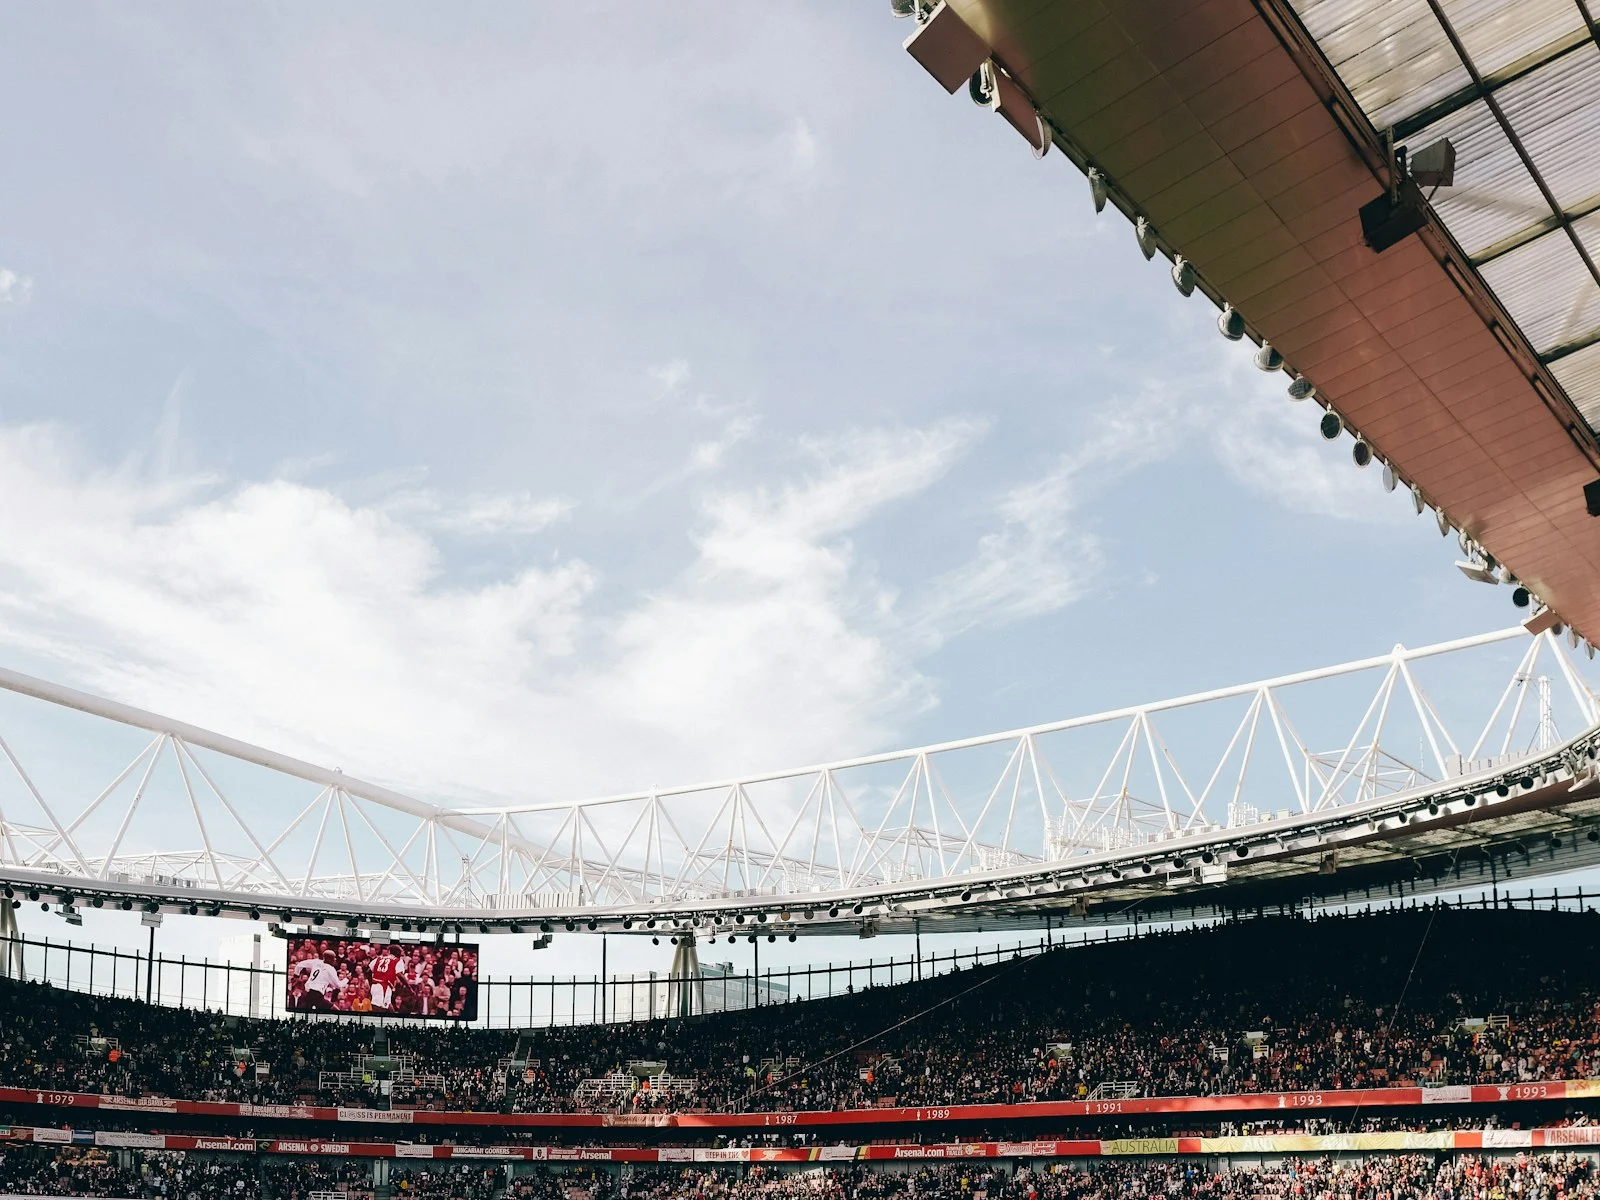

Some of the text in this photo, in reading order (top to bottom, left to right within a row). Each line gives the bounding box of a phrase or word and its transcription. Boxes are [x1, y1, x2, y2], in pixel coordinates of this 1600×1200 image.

[377, 959, 390, 972] 23
[311, 969, 319, 981] 9
[1516, 1086, 1547, 1098] 1993
[49, 1094, 75, 1105] 1979
[113, 1097, 136, 1105] ARSENAL
[1292, 1095, 1322, 1106] 1993
[1096, 1103, 1122, 1113] 1991
[366, 1111, 373, 1119] IS
[374, 1112, 412, 1121] PERMANENT
[775, 1115, 798, 1124] 1987
[926, 1109, 950, 1119] 1989
[1550, 1129, 1589, 1144] ARSENAL
[195, 1139, 254, 1151] Arsenal.com
[278, 1141, 350, 1154] ARSENAL SWEDEN
[1112, 1139, 1177, 1153] AUSTRALIA
[580, 1150, 612, 1160] Arsenal
[894, 1147, 944, 1158] Arsenal.com
